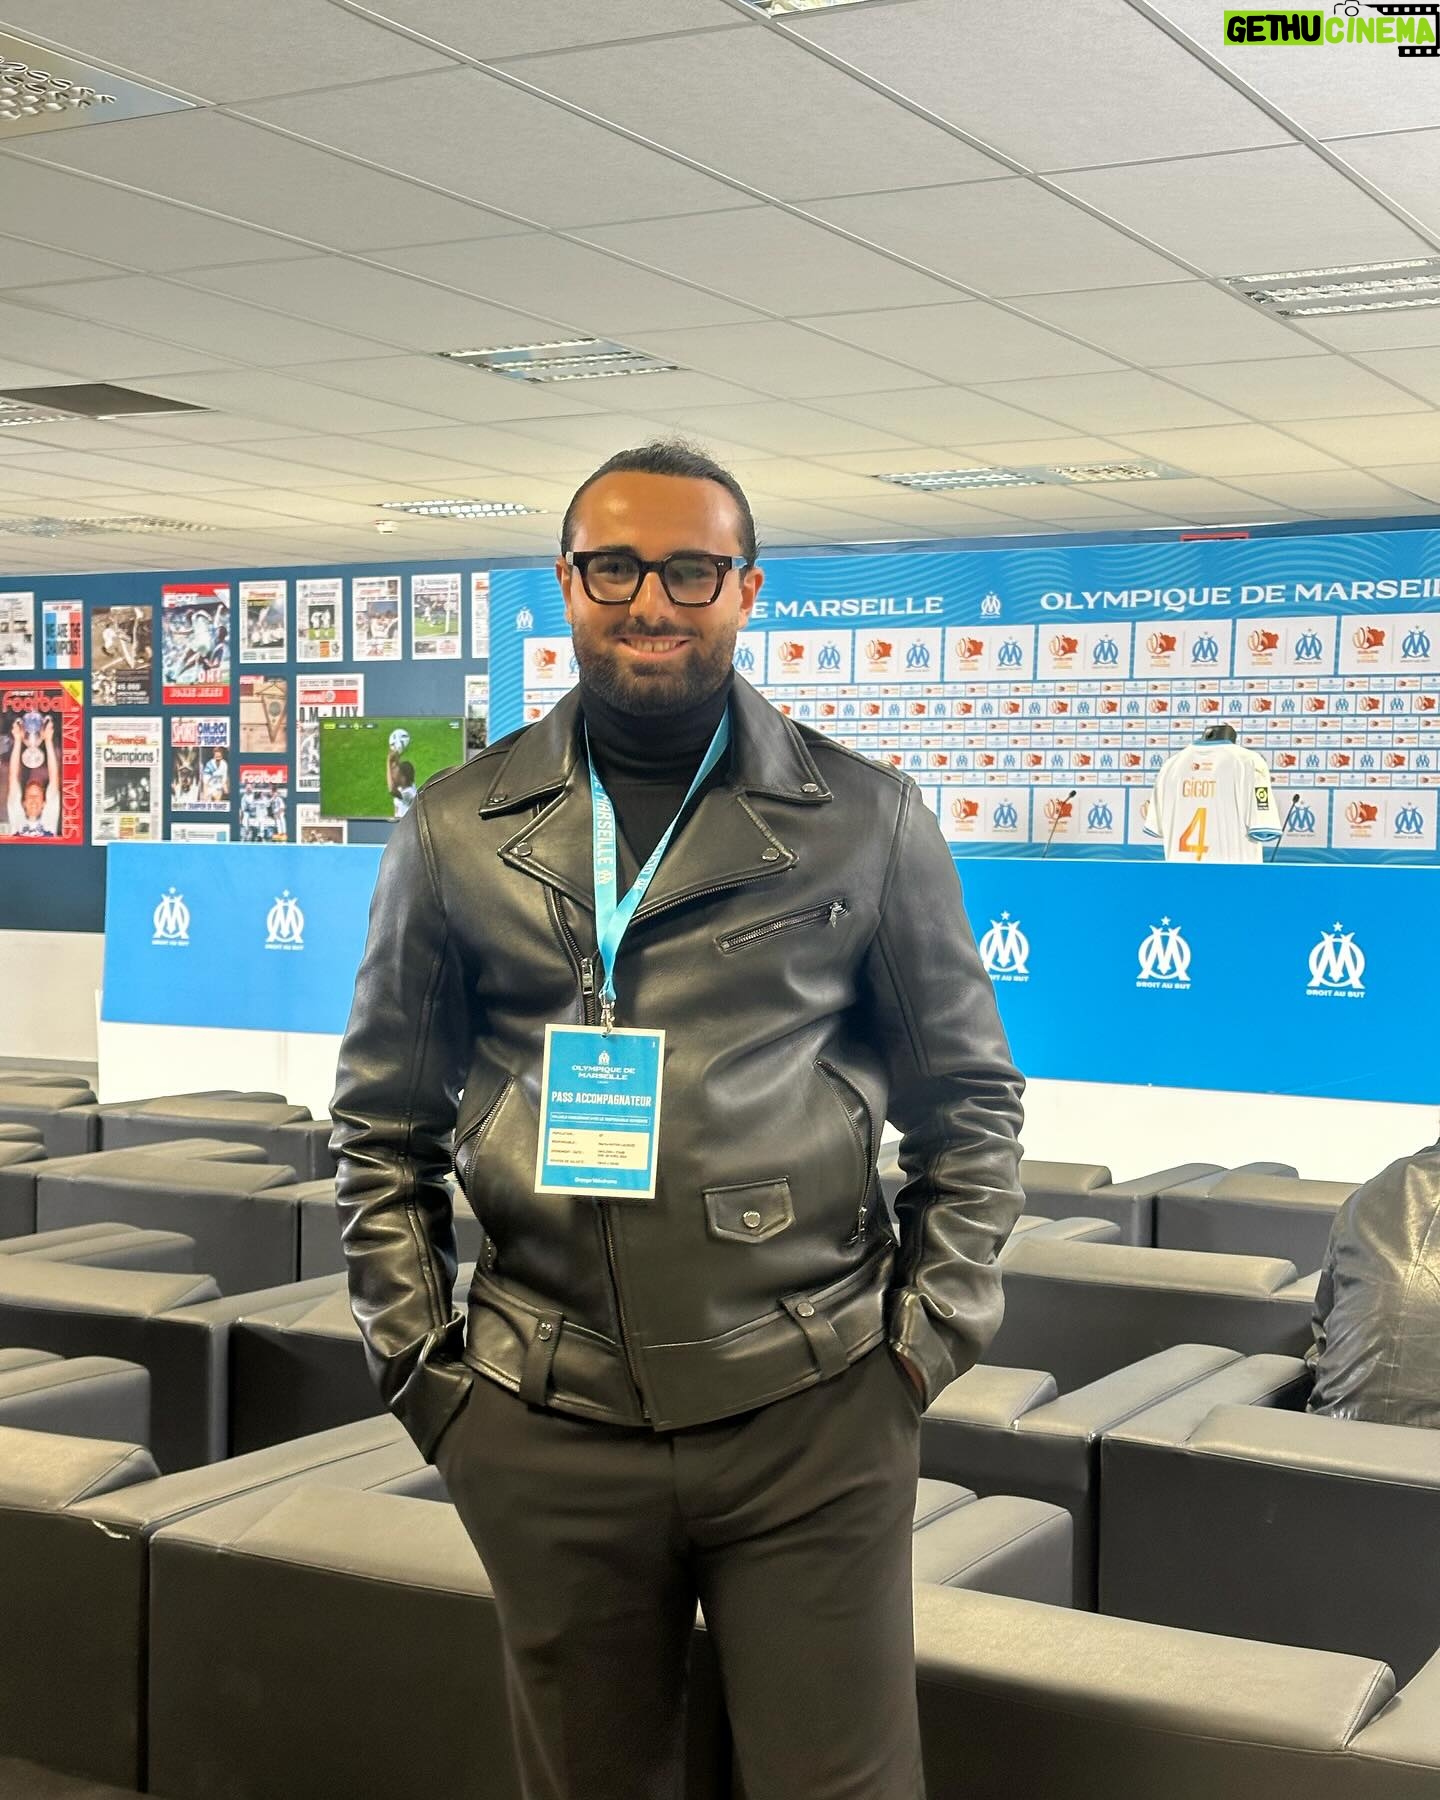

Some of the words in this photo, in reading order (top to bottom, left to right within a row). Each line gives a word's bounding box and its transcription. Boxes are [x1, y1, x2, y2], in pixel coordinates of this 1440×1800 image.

[1040, 586, 1231, 612] OLYMPIQUE
[1240, 584, 1286, 605] DE
[751, 601, 769, 619] E
[775, 596, 944, 618] MARSEILLE
[1179, 807, 1208, 861] 4
[1136, 981, 1161, 989] DROIT
[1306, 989, 1332, 997] DROIT
[572, 1065, 622, 1074] OLYMPIQUE
[578, 1072, 628, 1080] MARSEILLE
[551, 1091, 573, 1103] PASS
[575, 1092, 652, 1107] ACCOMPAGNATEUR
